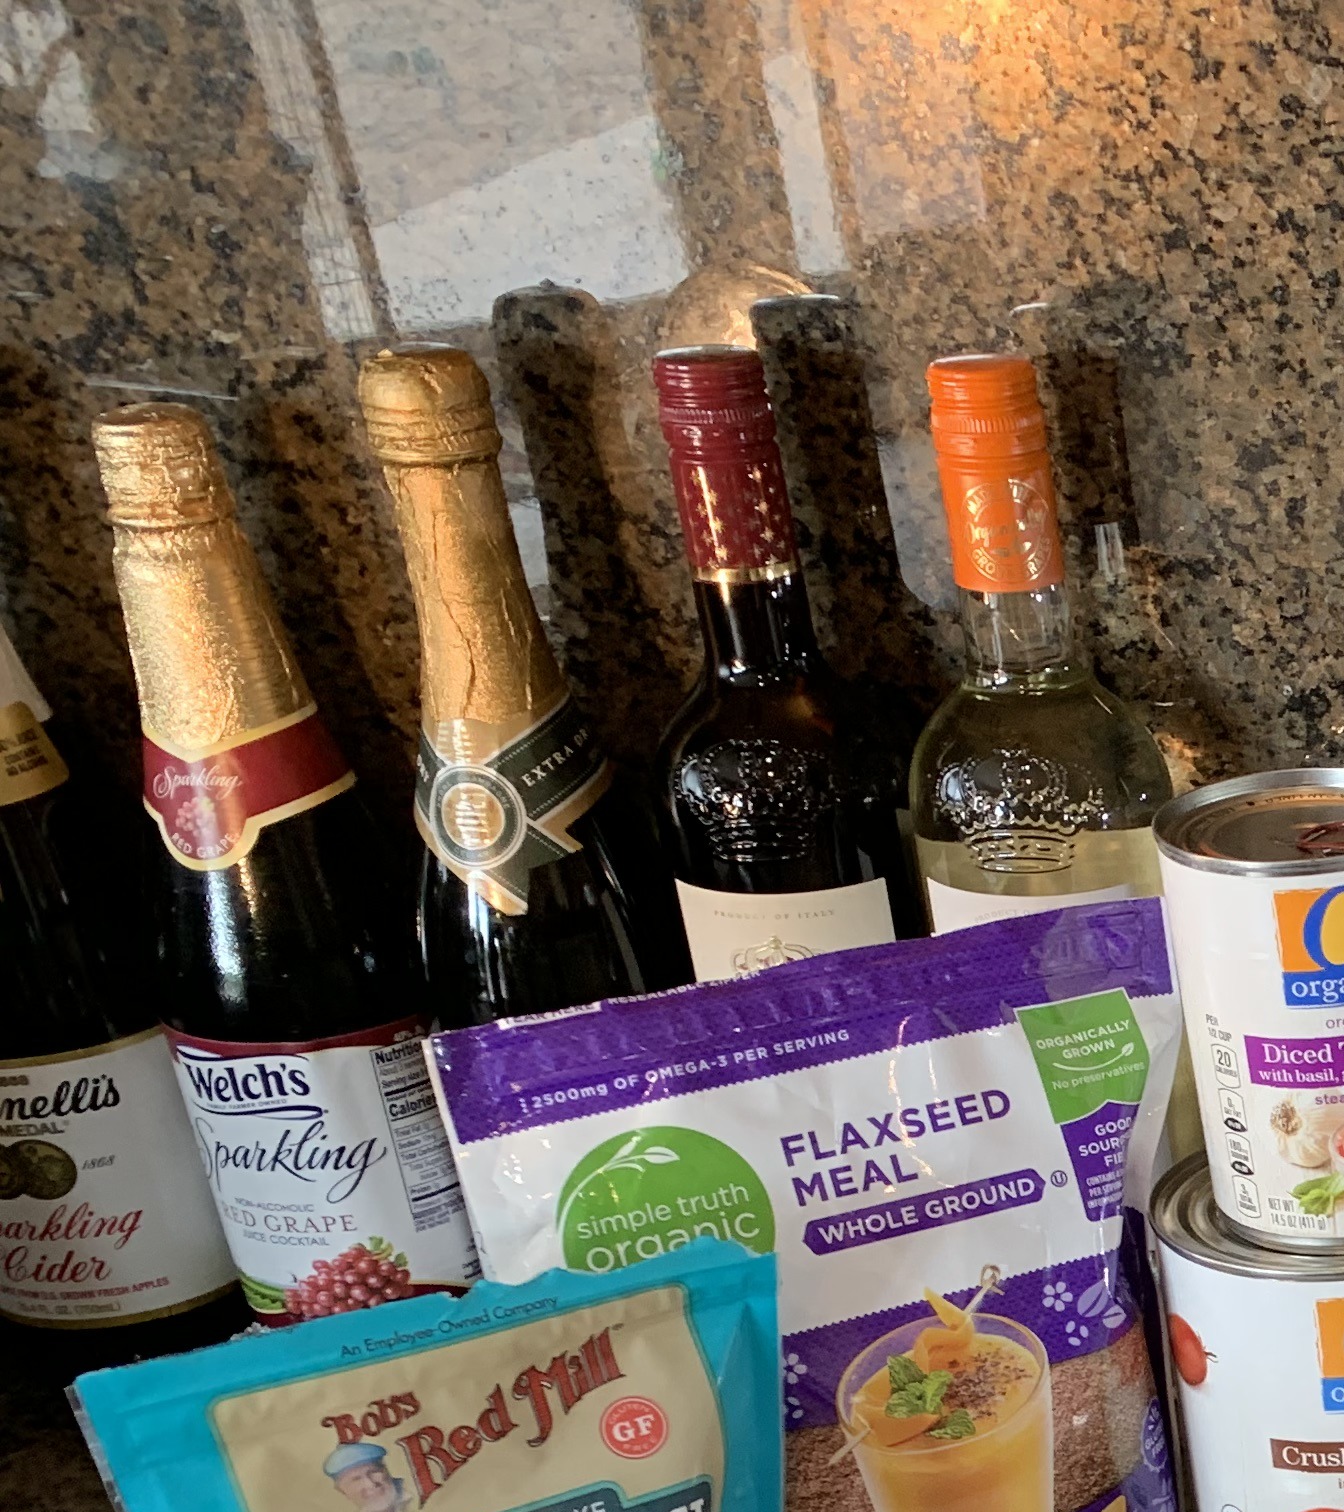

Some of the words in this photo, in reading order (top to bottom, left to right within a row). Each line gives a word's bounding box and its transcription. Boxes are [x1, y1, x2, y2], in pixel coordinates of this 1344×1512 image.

[153, 764, 243, 800] Sparkling
[521, 745, 573, 787] EXTRA
[1036, 1018, 1131, 1051] ORGANICALLY
[1062, 1038, 1116, 1060] GROWN
[1263, 1038, 1334, 1067] Diced
[532, 1082, 608, 1110] 2500mg
[613, 1072, 640, 1092] OF
[644, 1053, 728, 1083] OMEGA-3
[733, 1045, 769, 1066] PER
[773, 1029, 850, 1056] SERVING
[1051, 1079, 1067, 1091] No
[1070, 1061, 1145, 1088] preservatives
[1216, 1049, 1231, 1068] 20
[1258, 1067, 1292, 1084] with
[1294, 1065, 1340, 1087] basil,
[0, 1073, 120, 1120] nelli's
[183, 1062, 310, 1103] Welch's
[780, 1088, 1011, 1167] FLAXSEED
[195, 1117, 387, 1204] Sparkling
[790, 1154, 919, 1207] MEAL
[0, 1201, 144, 1250] arkling
[264, 1214, 358, 1234] GRAPE
[577, 1201, 671, 1240] simple
[679, 1182, 750, 1217] truth
[817, 1204, 918, 1246] WHOLE
[925, 1176, 1036, 1220] GROUND
[269, 1235, 330, 1246] COCKTAIL
[4, 1246, 112, 1283] Cider
[132, 1276, 170, 1293] APPLES
[340, 1343, 361, 1358] An
[364, 1312, 490, 1355] Employee-Owned
[493, 1295, 560, 1320] Company
[396, 1383, 518, 1510] Red
[513, 1327, 627, 1448] Mill
[611, 1413, 655, 1442] GF
